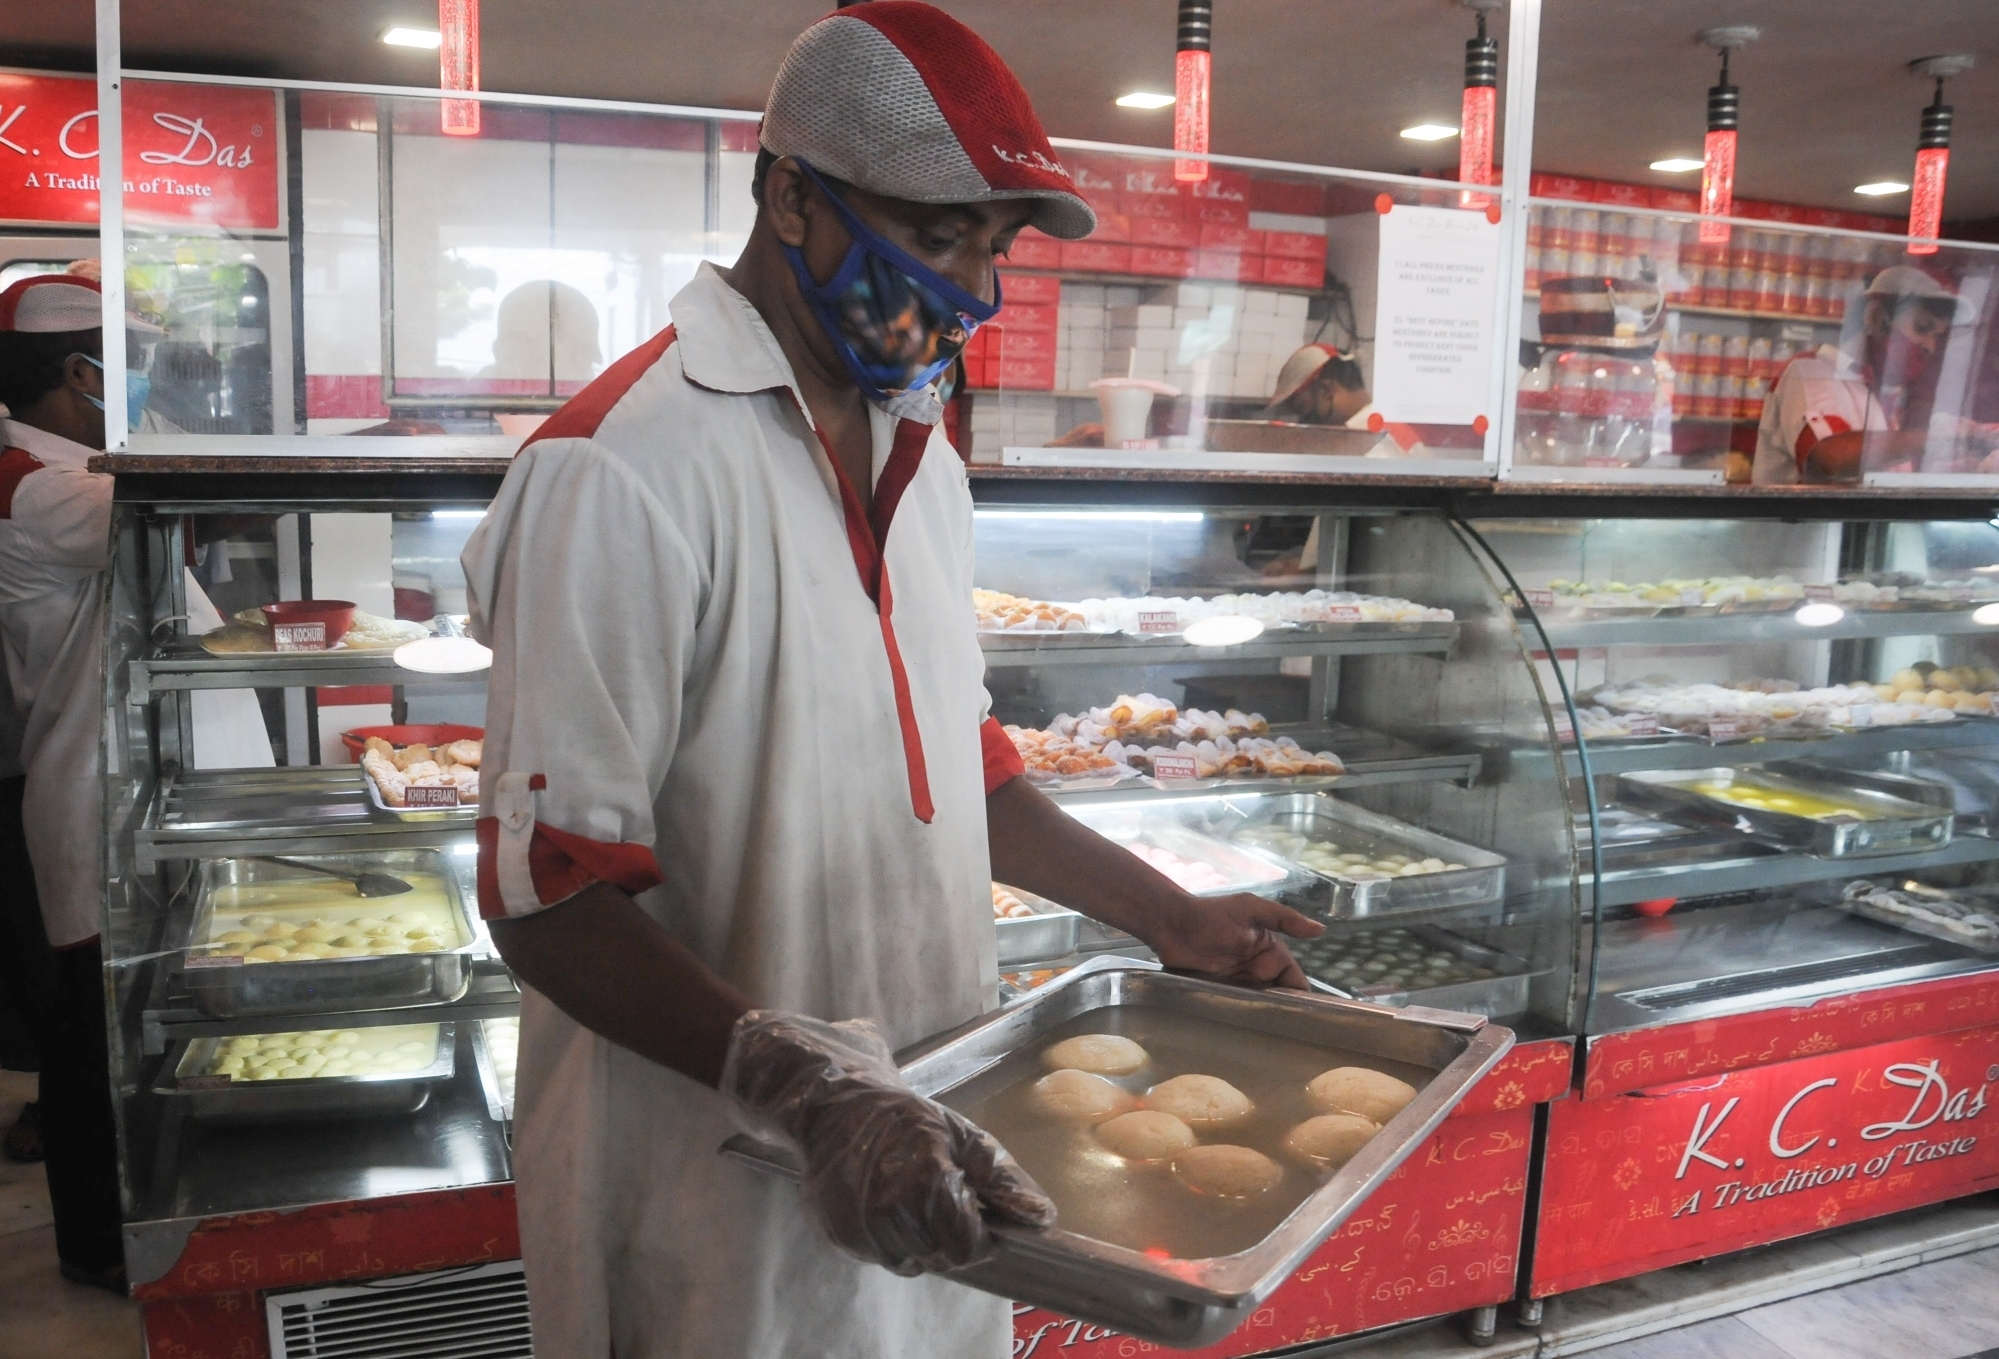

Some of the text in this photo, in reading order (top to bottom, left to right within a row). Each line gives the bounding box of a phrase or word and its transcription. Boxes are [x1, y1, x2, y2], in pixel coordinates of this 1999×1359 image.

[140, 112, 254, 170] Das
[25, 173, 212, 197] A Traditn of Taste
[294, 627, 324, 643] KOCHURI
[408, 789, 455, 803] KHIR PERAKI
[1675, 1096, 1745, 1180] K.
[1769, 1078, 1838, 1159] C.
[1860, 1059, 1988, 1141] Das
[1671, 1190, 1702, 1218] A
[1712, 1160, 1856, 1210] Tradition
[1863, 1144, 1904, 1178] of
[1902, 1136, 1978, 1167] Taste
